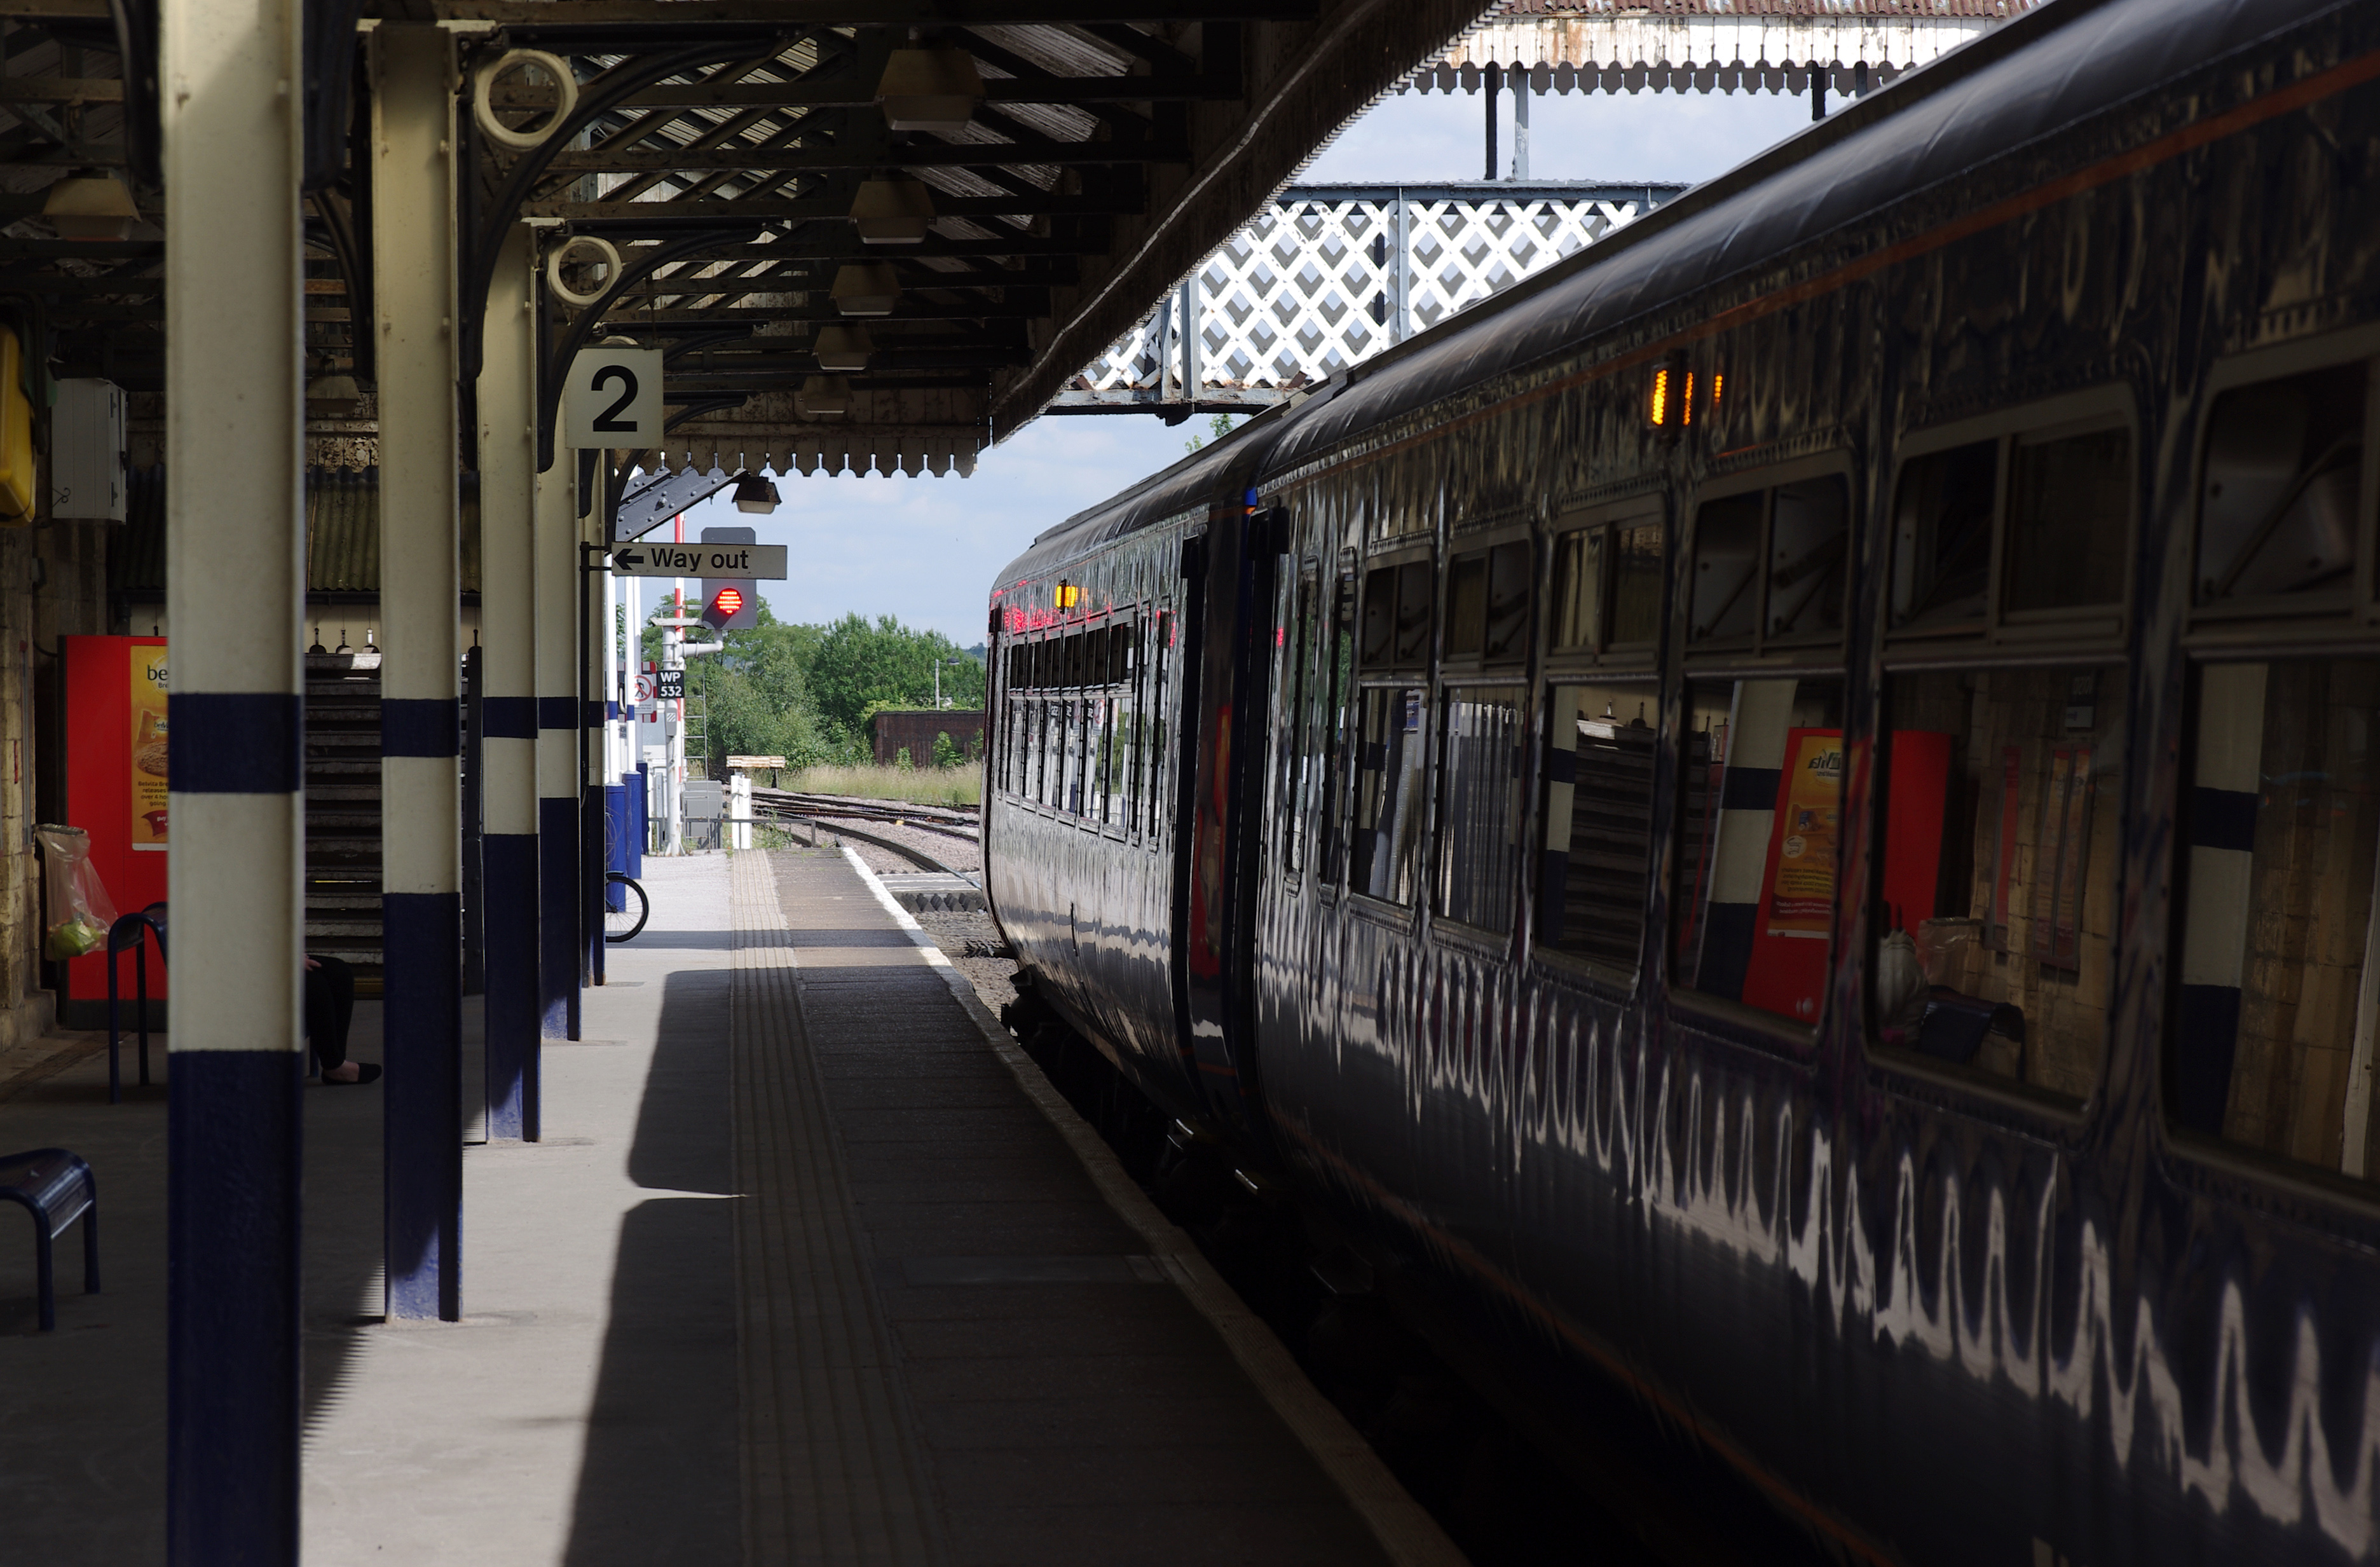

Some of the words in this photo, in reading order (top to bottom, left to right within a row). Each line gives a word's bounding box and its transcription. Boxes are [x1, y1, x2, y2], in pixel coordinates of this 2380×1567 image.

[591, 365, 639, 432] 2
[651, 548, 702, 572] Way
[711, 551, 749, 570] out
[660, 672, 681, 683] WP
[660, 686, 682, 697] 532
